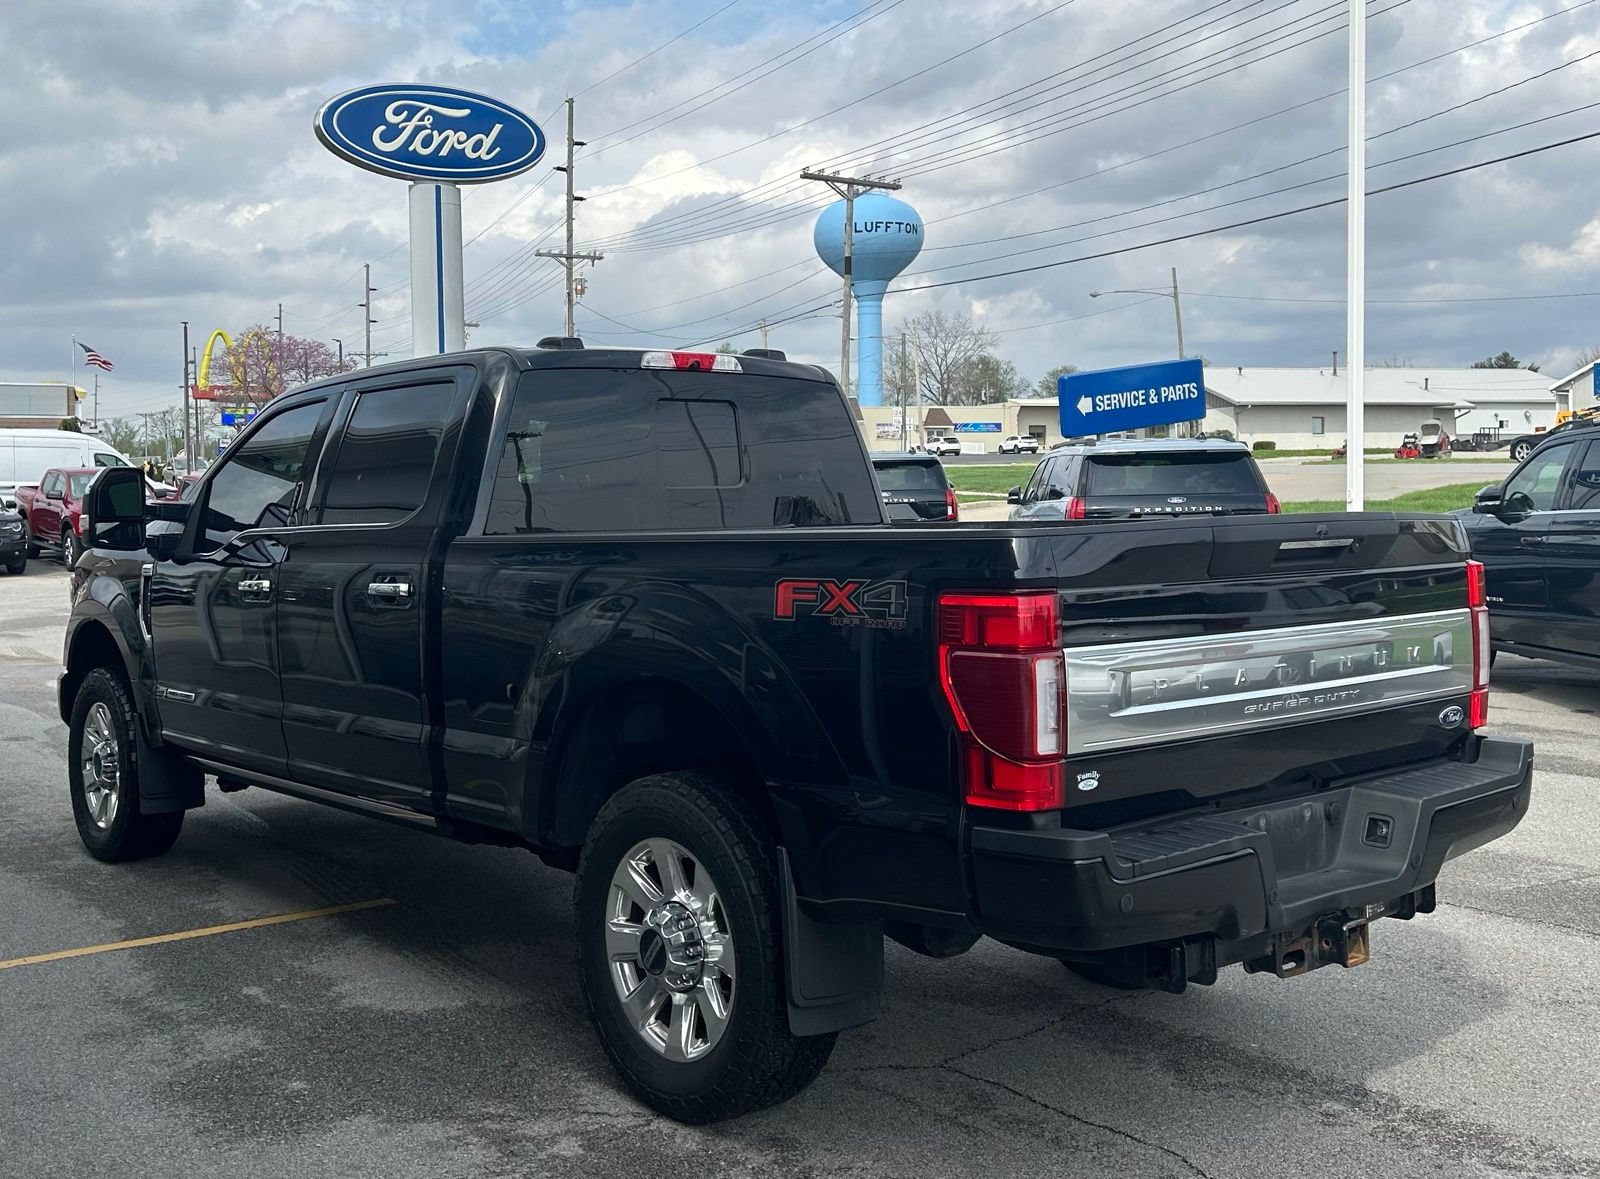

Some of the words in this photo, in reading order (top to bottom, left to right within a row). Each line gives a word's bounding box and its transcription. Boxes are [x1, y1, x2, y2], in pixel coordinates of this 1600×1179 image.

[372, 99, 504, 161] Ford
[844, 221, 918, 235] LUFFTON
[1095, 389, 1147, 412] SERVICE
[1148, 388, 1159, 404] &
[1161, 382, 1198, 403] PARTS
[774, 578, 909, 622] FX4
[1153, 646, 1421, 696] PLATINUM
[1244, 697, 1311, 714] SUPER
[1314, 689, 1361, 704] DUTY
[1077, 771, 1100, 781] Family
